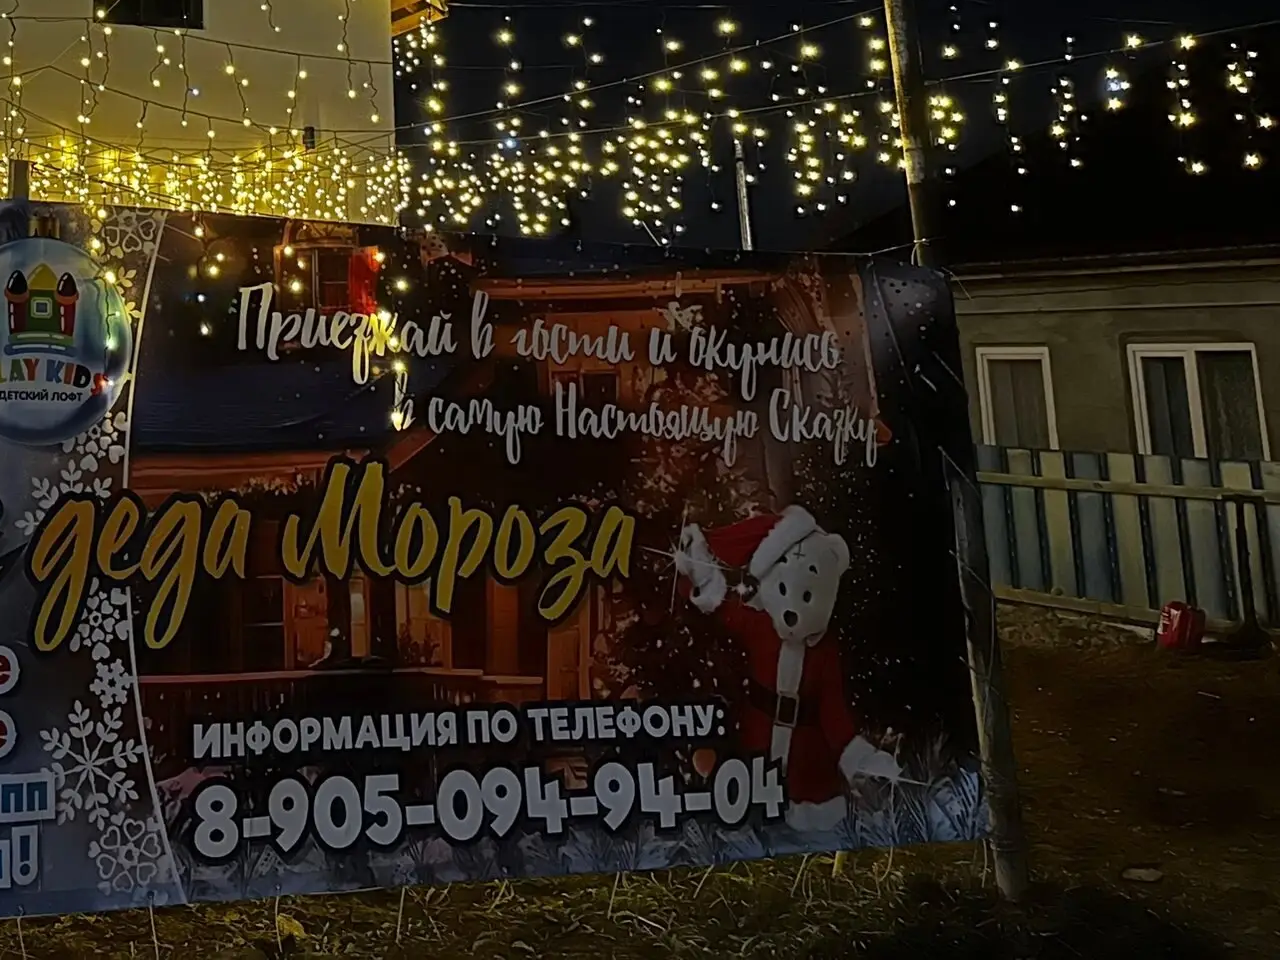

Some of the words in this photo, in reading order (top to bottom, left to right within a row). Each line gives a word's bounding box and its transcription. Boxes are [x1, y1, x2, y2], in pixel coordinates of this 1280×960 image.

[46, 359, 109, 397] KIDS
[236, 281, 458, 385] Приезжай
[470, 290, 496, 360] в
[509, 318, 636, 366] гости
[648, 327, 678, 366] и
[688, 325, 841, 402] окунись
[50, 392, 84, 402] ЛОФТ
[428, 396, 545, 465] самую
[554, 381, 760, 468] Настоящую
[769, 388, 878, 468] Сказку
[32, 492, 250, 653] деда
[282, 460, 637, 621] Мороза
[192, 708, 459, 760] ИНФОРМАЦИЯ
[466, 706, 519, 746] ПО
[526, 703, 726, 744] ТЕЛЕФОНУ:
[192, 755, 786, 860] 8-905-094-94-04
